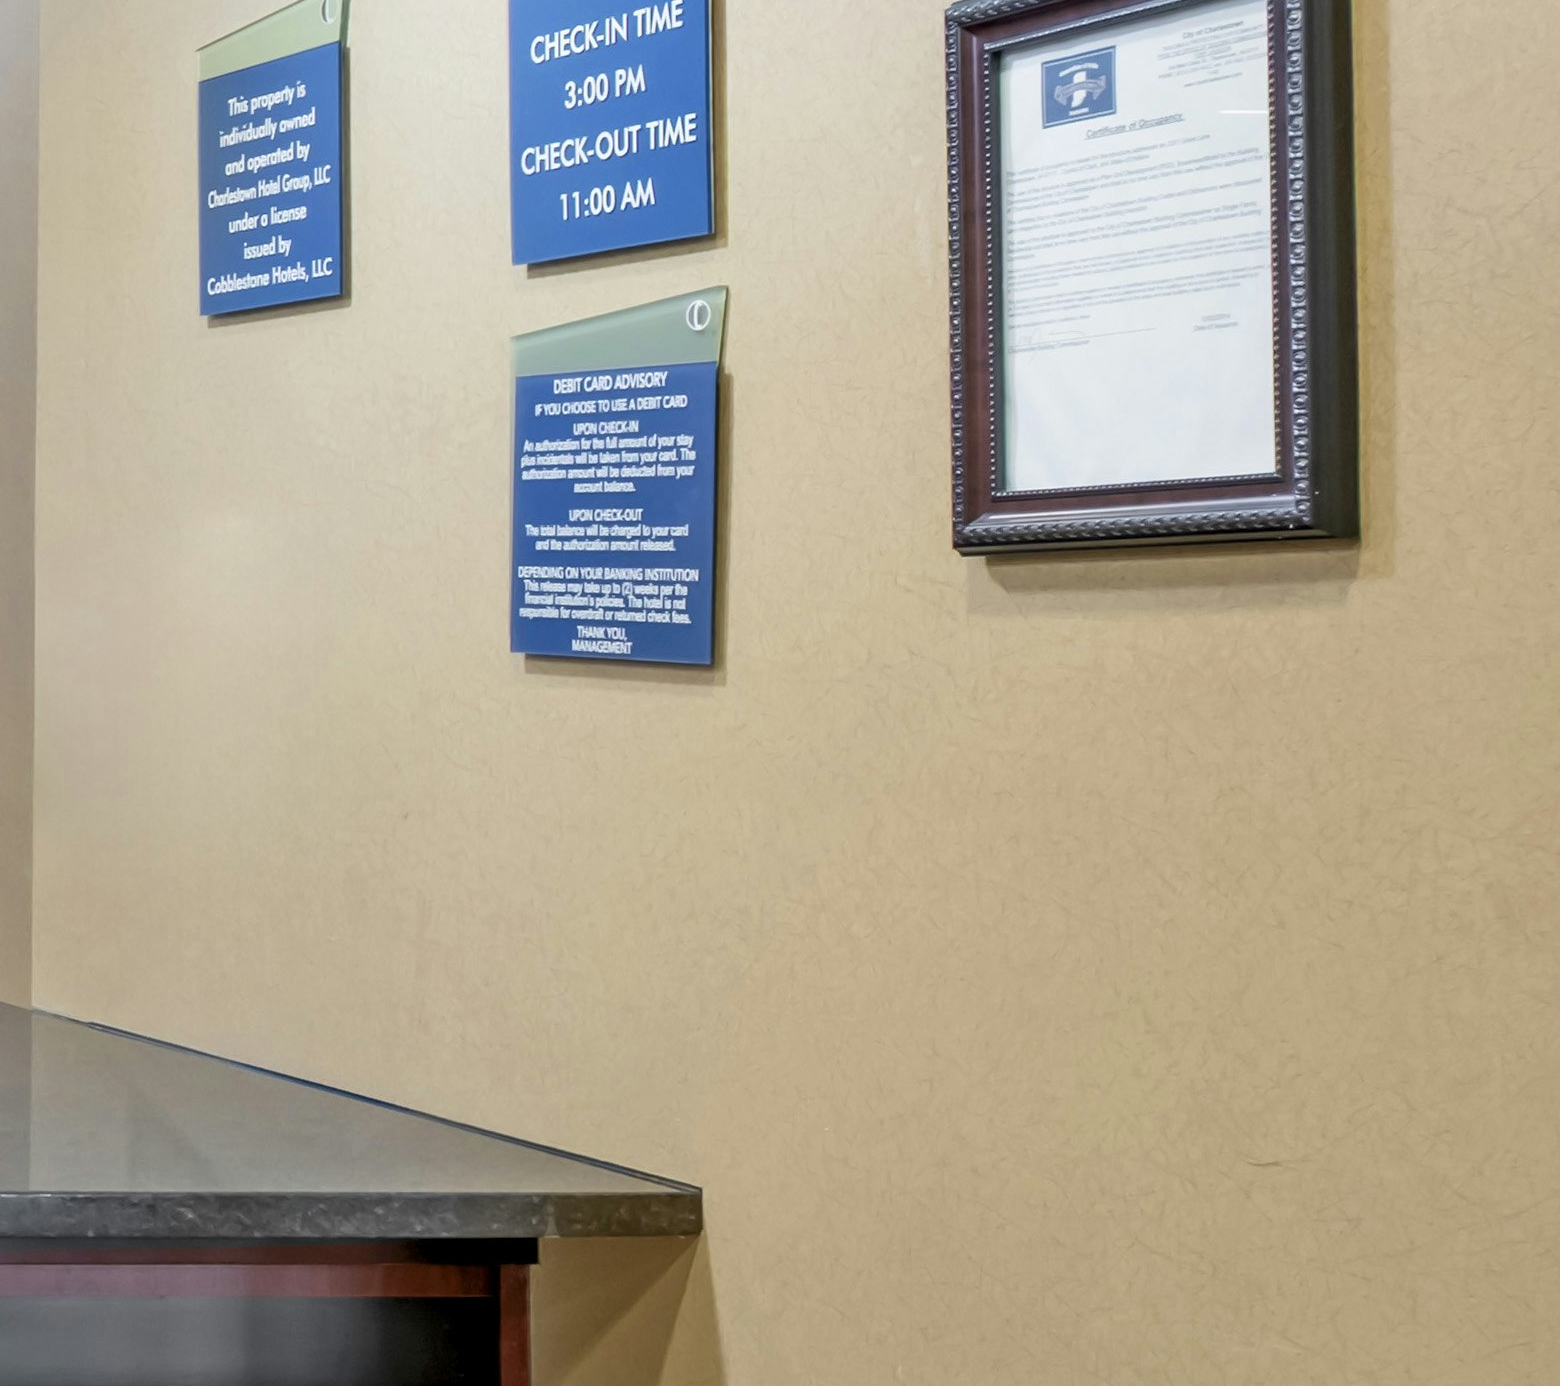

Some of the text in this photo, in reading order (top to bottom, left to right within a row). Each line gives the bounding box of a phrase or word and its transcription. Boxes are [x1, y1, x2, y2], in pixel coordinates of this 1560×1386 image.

[530, 13, 628, 64] CHECK-IN
[228, 80, 306, 117] This property is
[565, 64, 646, 109] 3:00 PM
[220, 106, 315, 148] individually owned
[1086, 124, 1126, 139] Certificate
[1129, 121, 1138, 131] of
[521, 113, 697, 175] CHECK-OUT TIME
[225, 140, 310, 176] and operated by
[208, 165, 331, 208] Charlestown Hotel Group, LLC
[560, 177, 656, 221] 11:00 AM
[229, 206, 307, 233] under a license
[244, 234, 291, 259] issued by
[208, 257, 333, 295] Cobblestone Hotels, LLC
[554, 371, 668, 394] DEBIT CARD ADVISORY
[535, 395, 688, 417] IF YOU CHOOSE TO USE A DEBIT CARD
[573, 420, 639, 436] UPON CHECK-IN
[569, 509, 643, 522] UPON CHECK-OUT
[518, 566, 699, 582] DEPENDING ON YOUR BANKING INSTITUTION
[577, 625, 627, 641] THANK YOU,
[572, 640, 632, 654] MANAGEMENT
